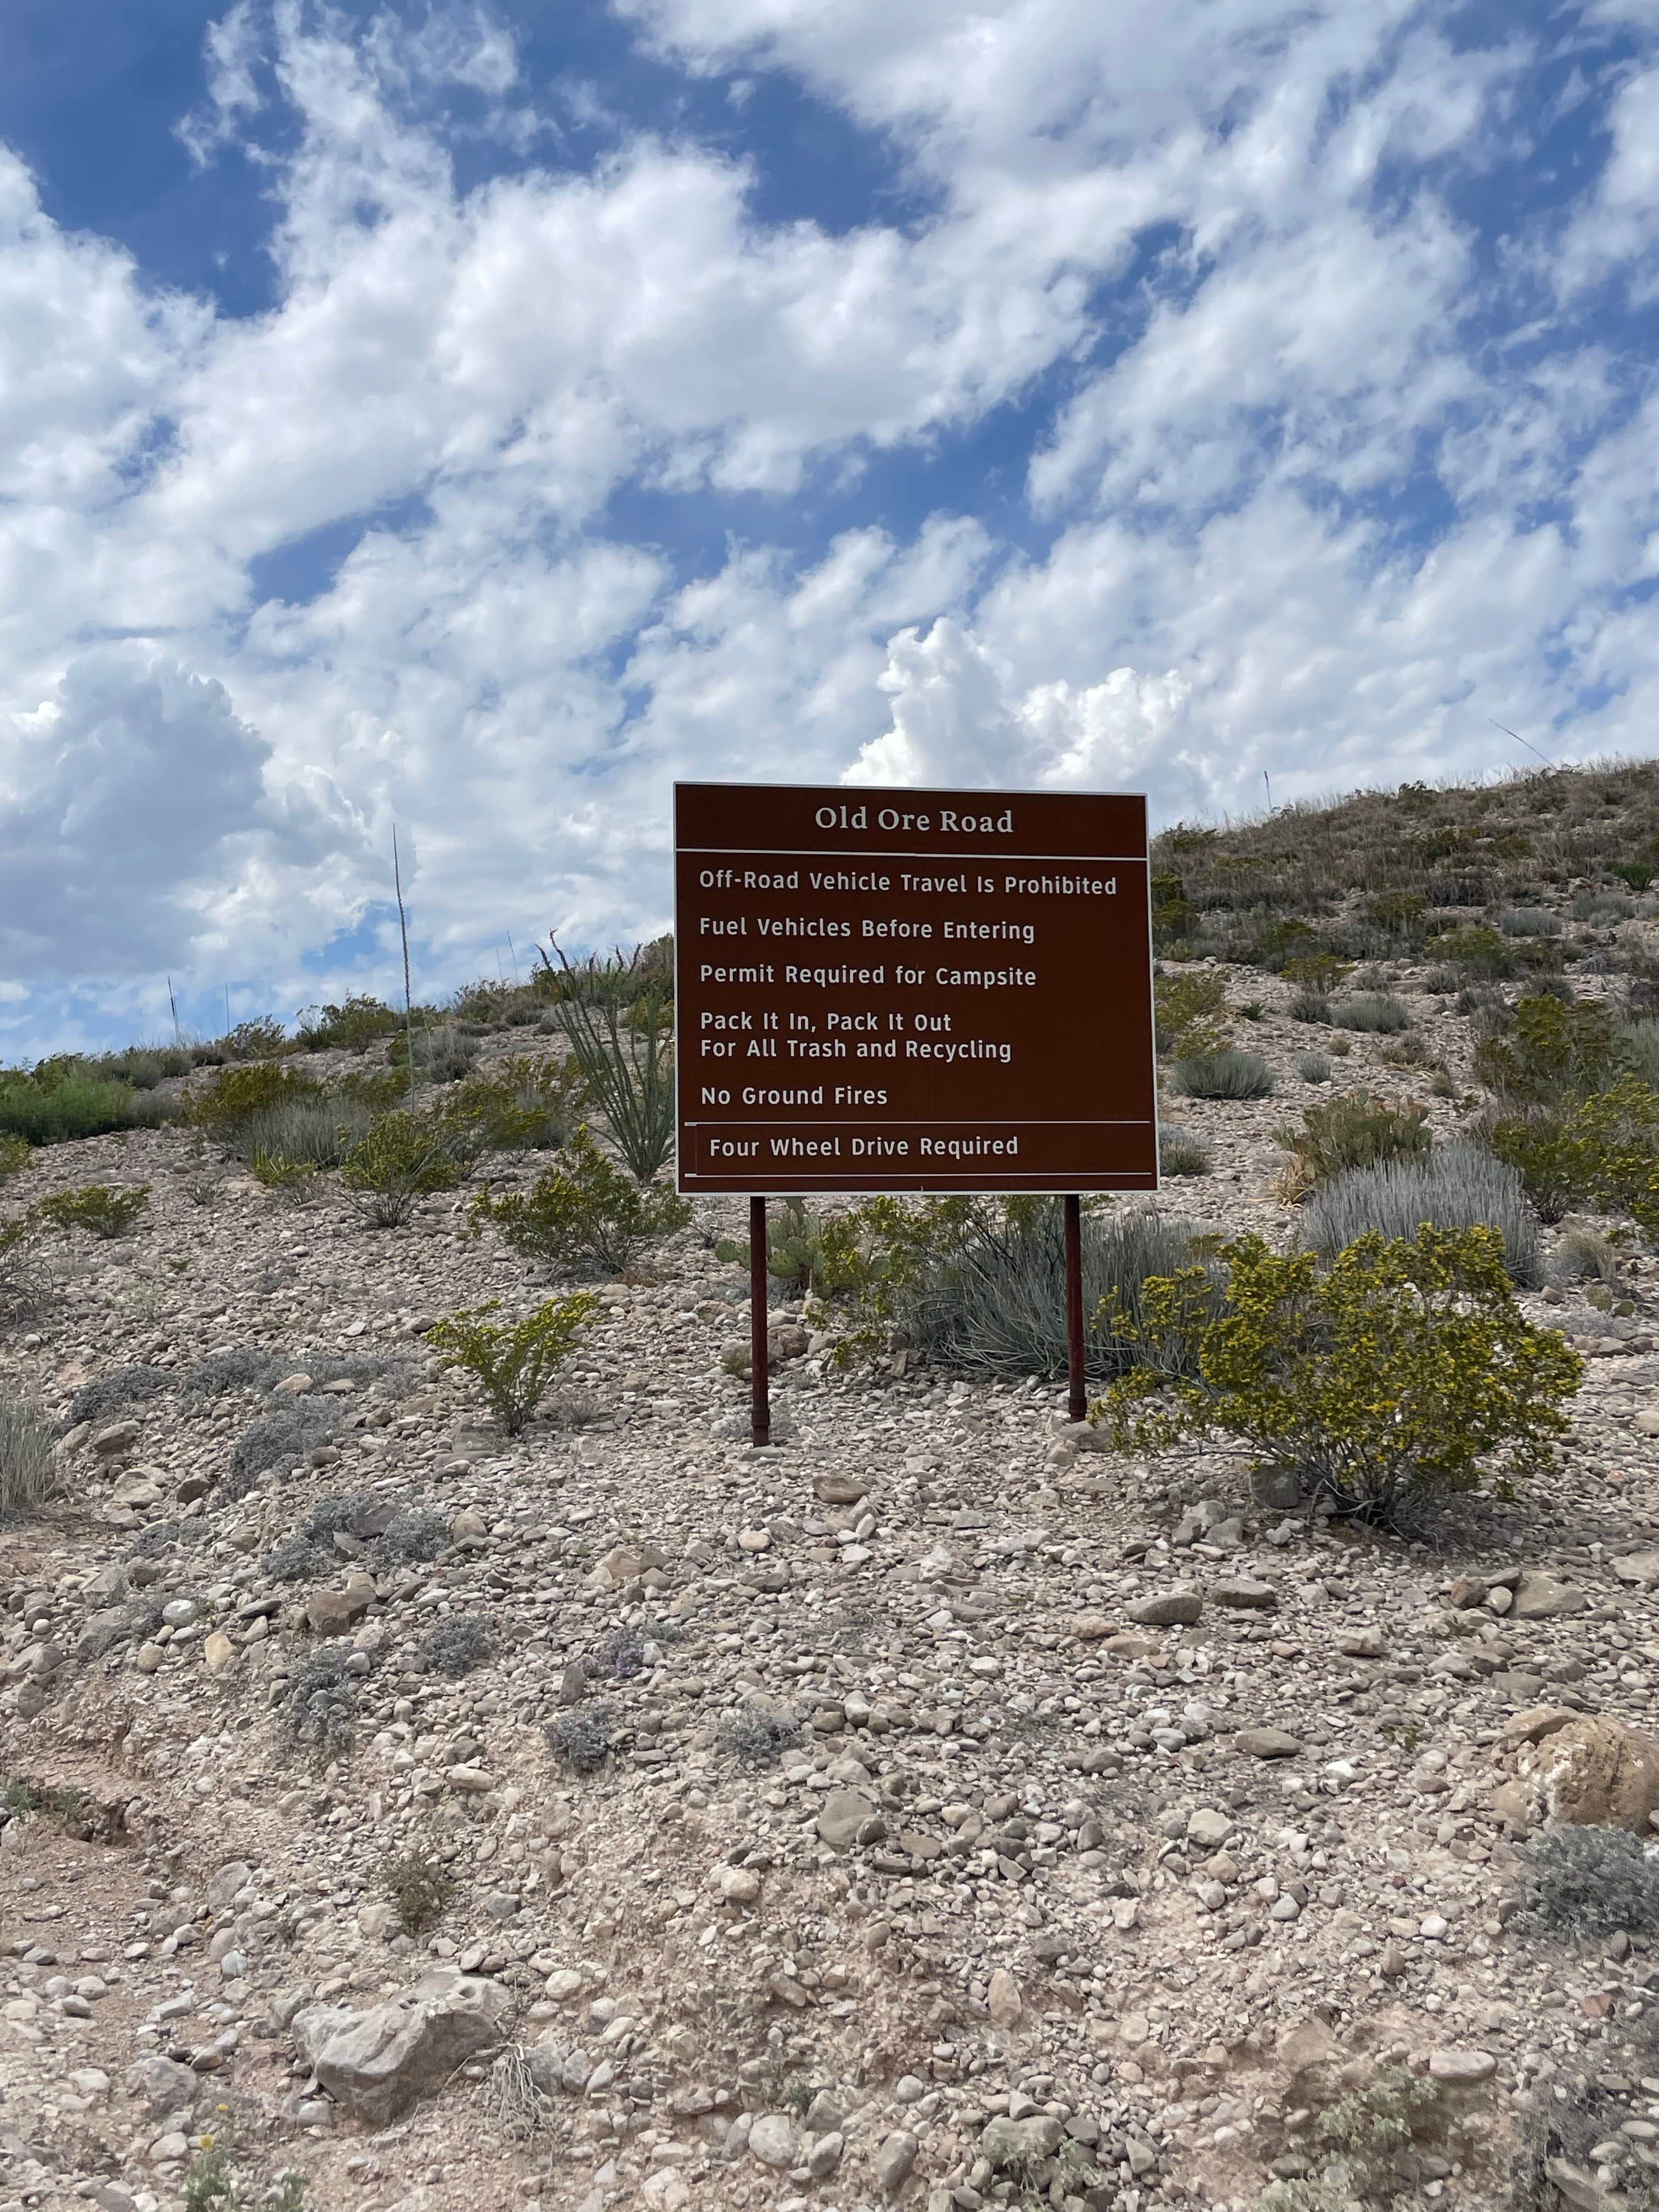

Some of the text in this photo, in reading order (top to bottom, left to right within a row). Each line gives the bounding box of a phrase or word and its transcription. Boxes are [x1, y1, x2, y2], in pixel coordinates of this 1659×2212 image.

[815, 805, 1014, 833] Old Ore Road
[699, 870, 1116, 895] Off-Road Vehicle Travel Is Prohibited
[700, 917, 1034, 944] Fuel Vehicles Before Entering
[701, 963, 1036, 990] Permit Required for Campsite
[701, 1011, 951, 1033] Pack It In, Pack It Out
[701, 1039, 1011, 1063] For All Trash and Recycling
[702, 1085, 887, 1104] No Ground Fires
[710, 1136, 1018, 1160] Four Wheel Drive Required
